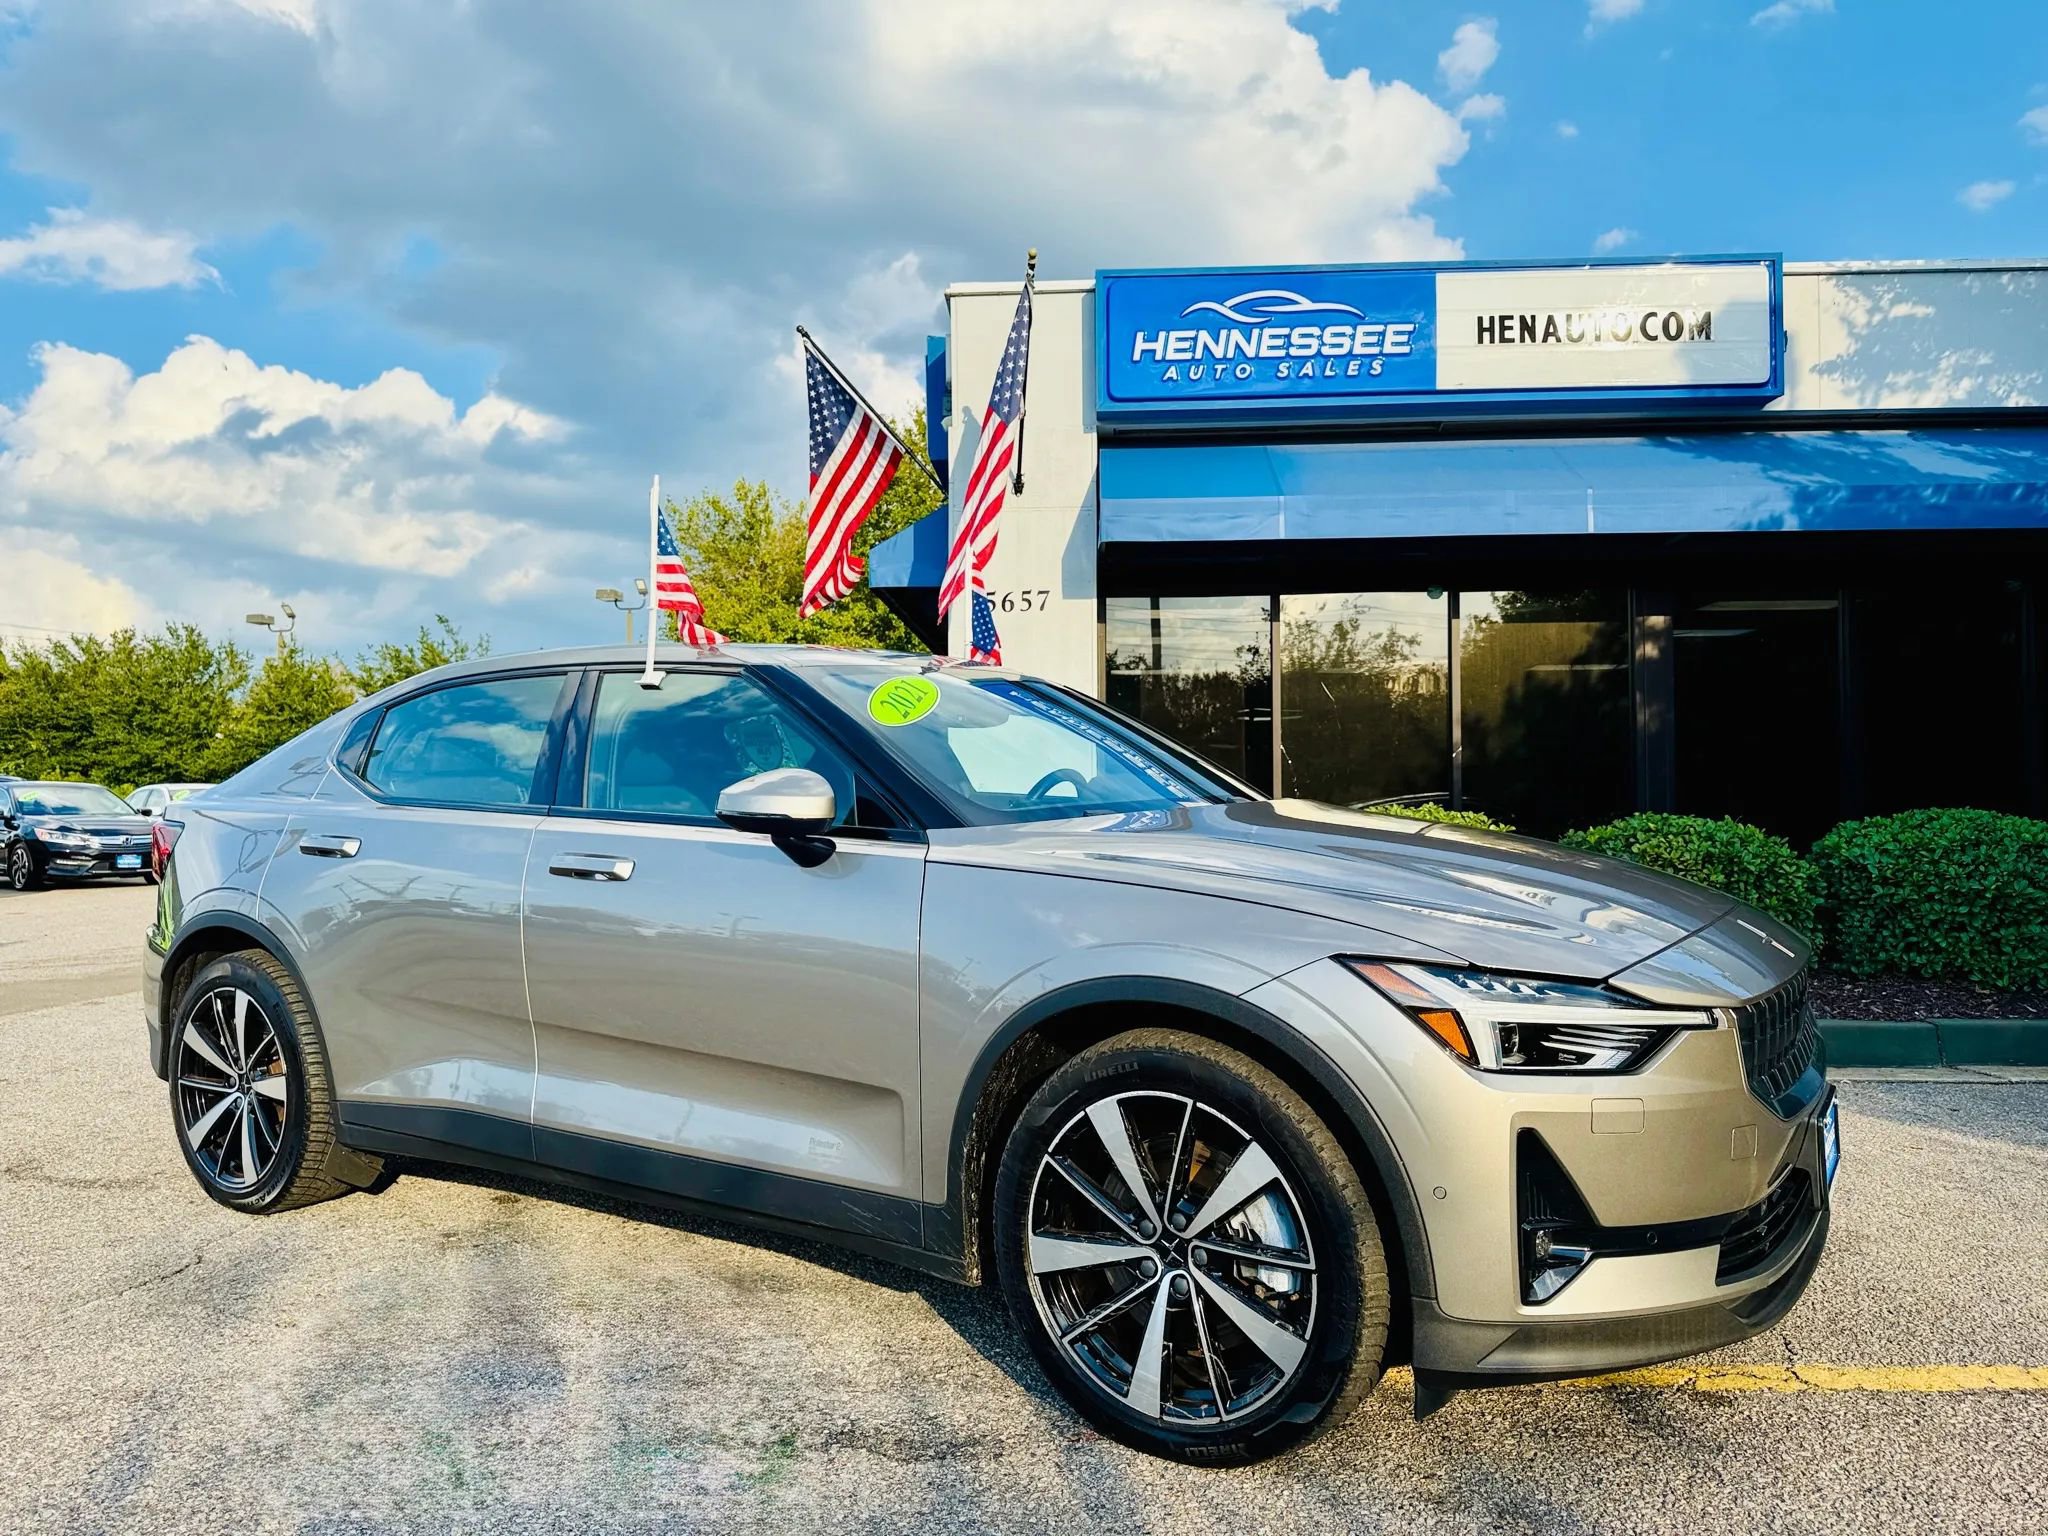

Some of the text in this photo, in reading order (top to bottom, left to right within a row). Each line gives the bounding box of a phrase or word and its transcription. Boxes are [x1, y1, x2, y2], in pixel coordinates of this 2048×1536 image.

[1132, 323, 1416, 361] HENNESSEE
[1163, 358, 1385, 381] AUTO SALES
[986, 589, 1050, 613] 5657
[880, 680, 929, 719] 2021
